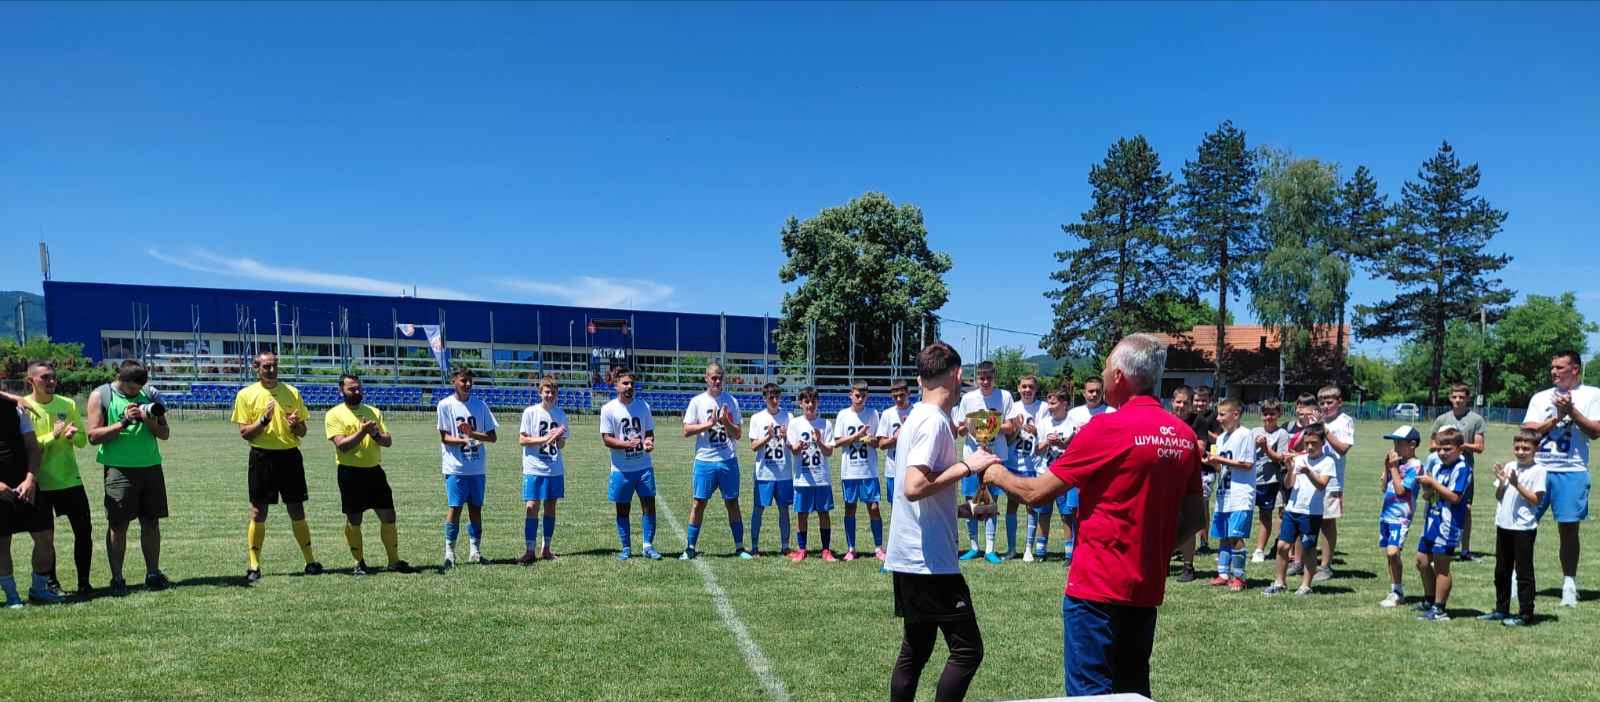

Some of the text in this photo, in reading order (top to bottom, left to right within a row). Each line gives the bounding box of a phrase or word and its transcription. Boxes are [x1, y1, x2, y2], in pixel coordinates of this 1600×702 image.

[709, 428, 727, 443] 26
[1160, 426, 1176, 436] ФС
[764, 443, 784, 460] 26
[801, 451, 821, 466] 26
[849, 444, 868, 459] 26
